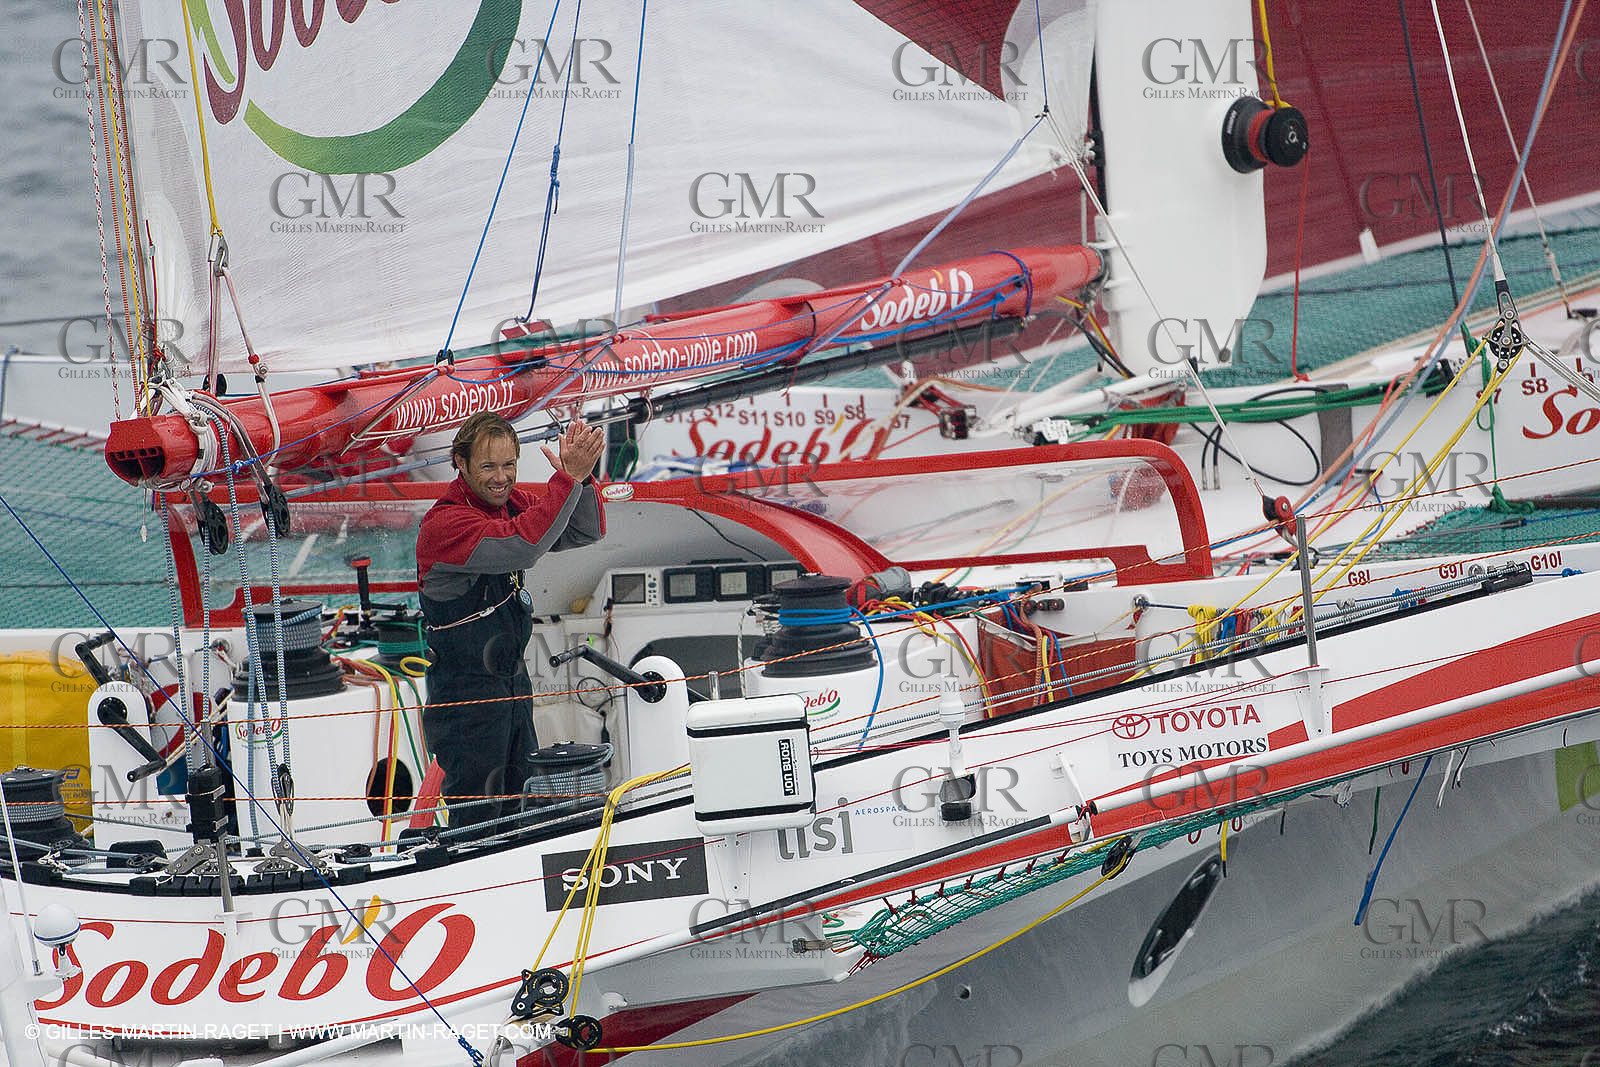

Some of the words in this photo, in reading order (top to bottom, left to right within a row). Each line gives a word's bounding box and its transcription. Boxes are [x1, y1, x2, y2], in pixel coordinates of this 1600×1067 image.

[1521, 377, 1549, 396] S8
[704, 403, 735, 419] S12
[738, 409, 768, 426] S11
[774, 411, 805, 427] S10
[814, 410, 836, 425] S9
[844, 404, 866, 420] S8
[671, 414, 888, 465] Sodeb'O
[1154, 704, 1262, 734] TOYOTA
[780, 740, 792, 772] BUOY
[1118, 748, 1173, 768] TOYS
[1178, 737, 1267, 762] MOTORS
[783, 773, 794, 794] JON
[561, 857, 688, 892] SONY
[34, 894, 476, 1010] Sodeb'O
